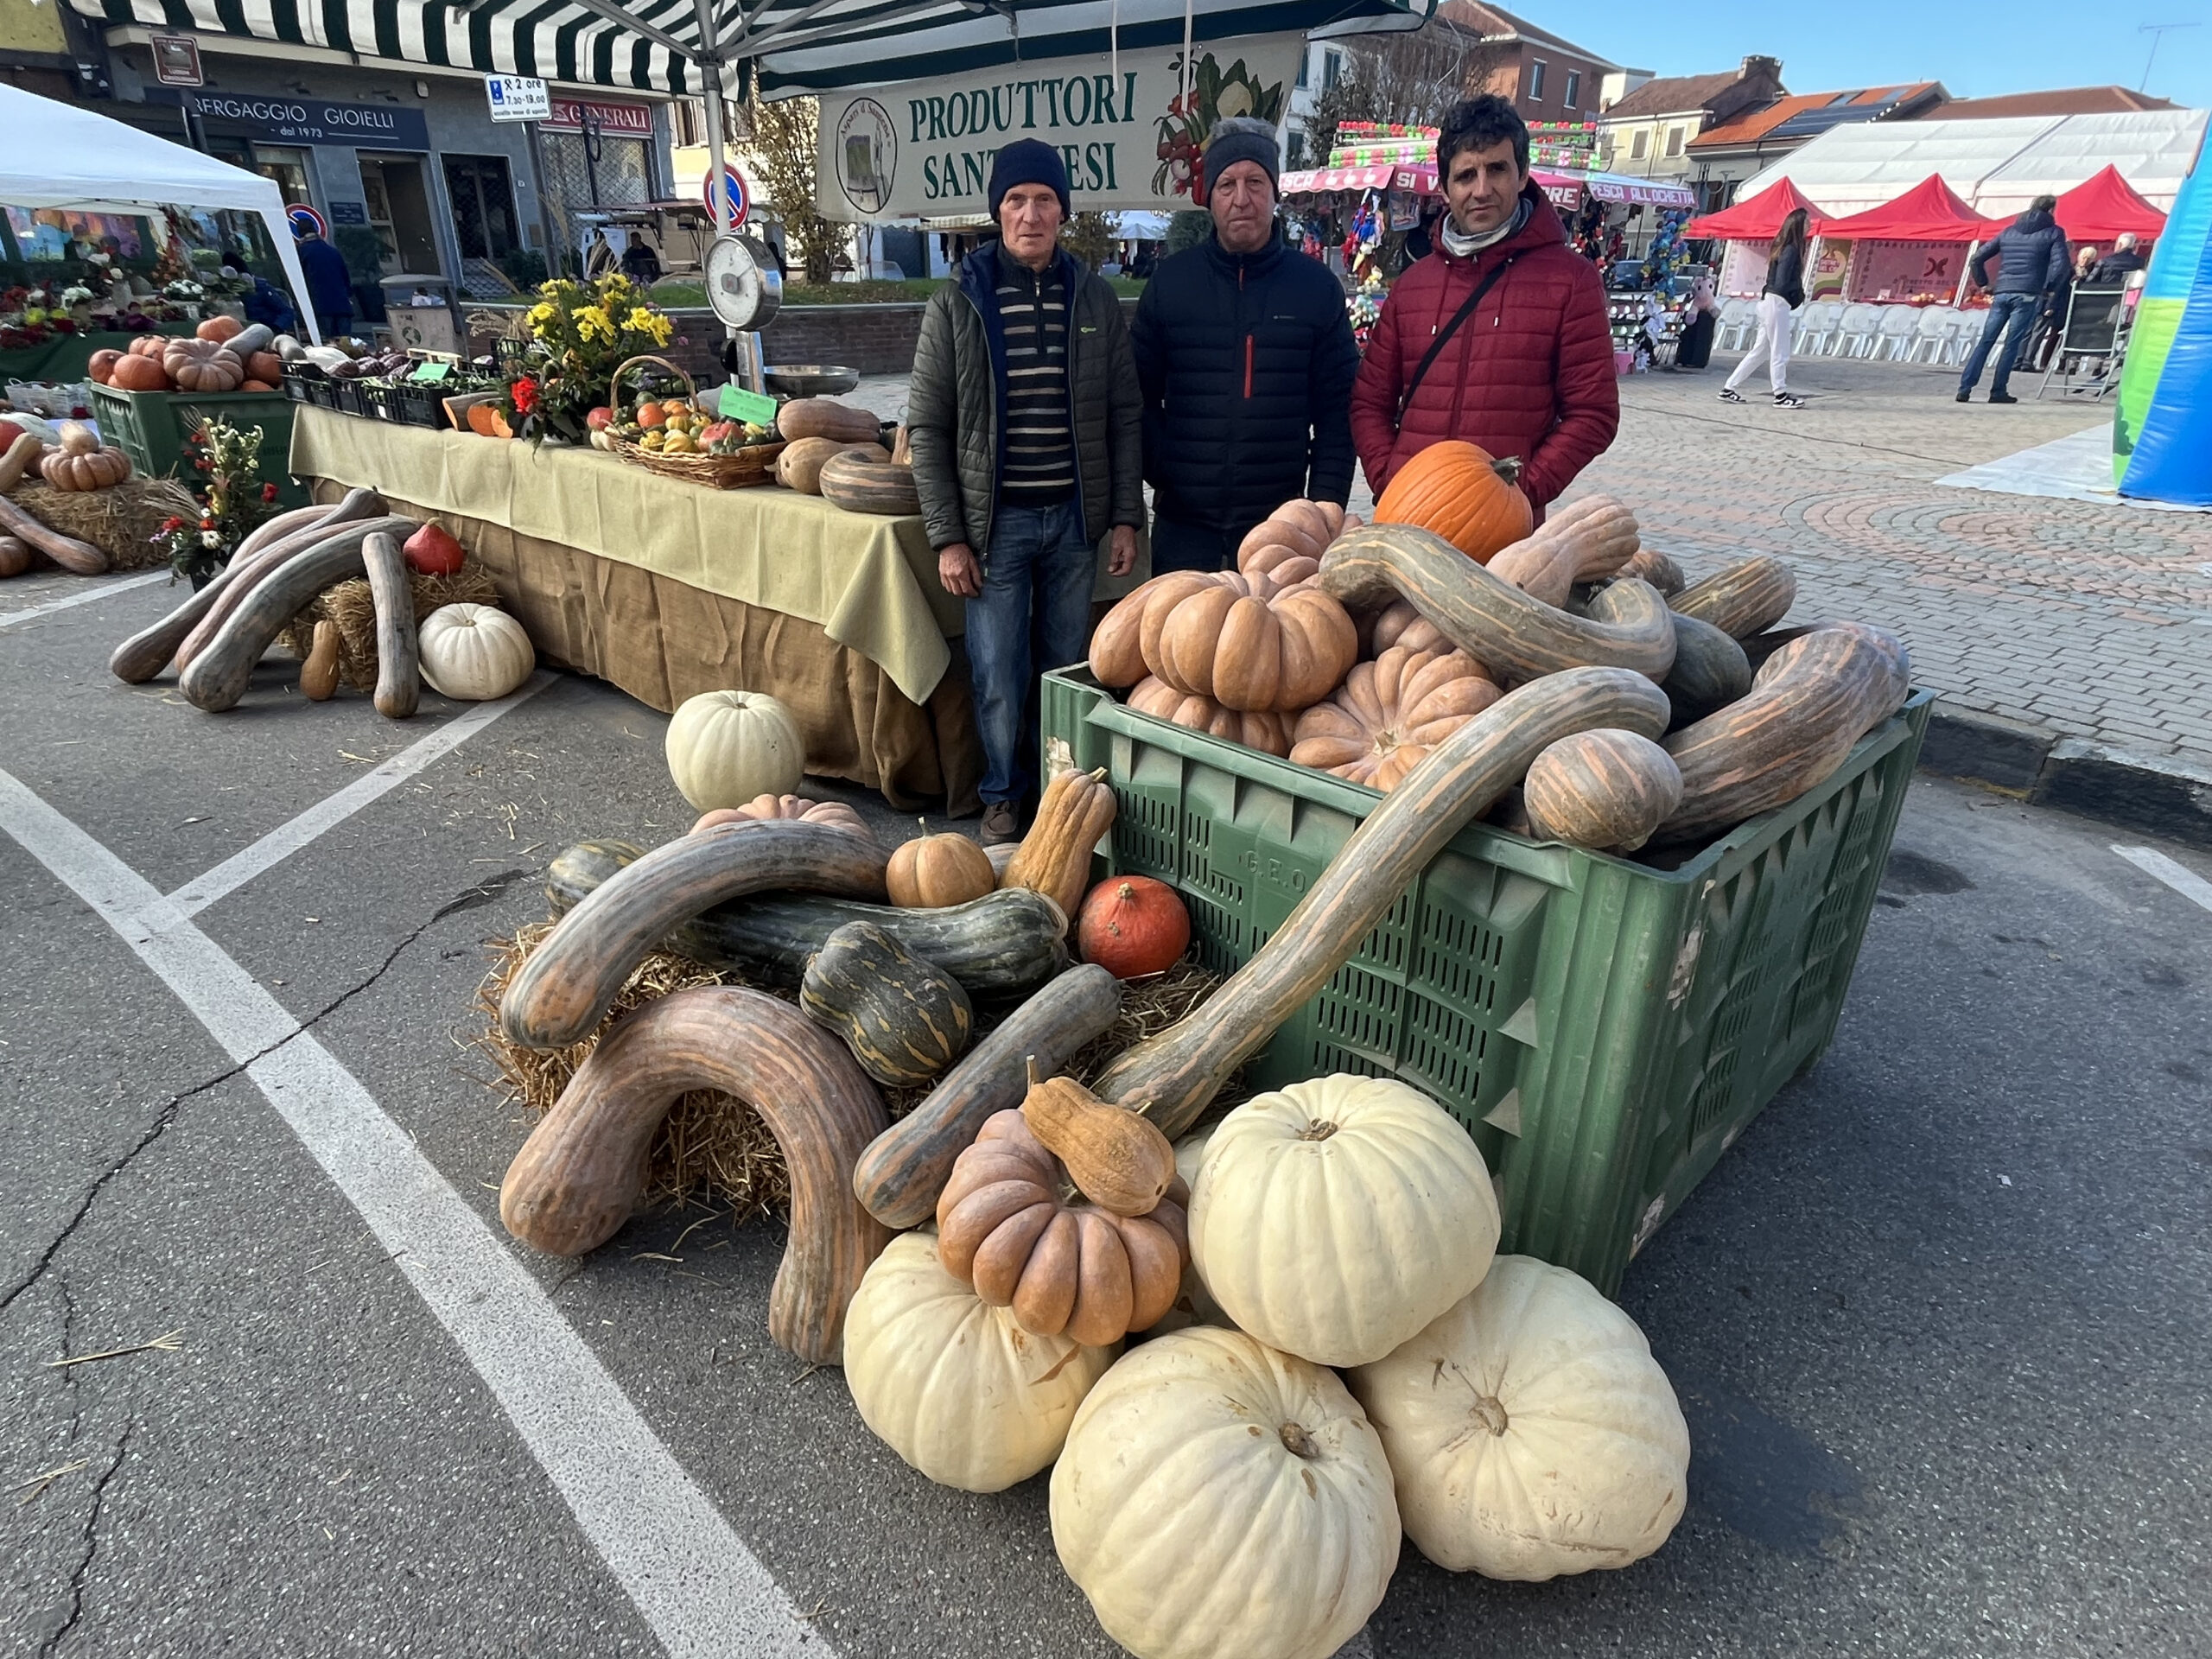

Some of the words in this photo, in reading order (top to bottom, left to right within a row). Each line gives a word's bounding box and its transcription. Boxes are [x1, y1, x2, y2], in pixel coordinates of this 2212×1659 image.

[515, 78, 523, 90] 2
[526, 79, 542, 90] ore
[908, 72, 1138, 143] PRODUTTORI
[324, 107, 395, 129] GIOIELLI
[280, 125, 296, 137] dal
[298, 127, 323, 138] 1973
[924, 142, 1119, 200] SANESI
[1396, 173, 1416, 189] SI
[1590, 182, 1624, 200] PESCA
